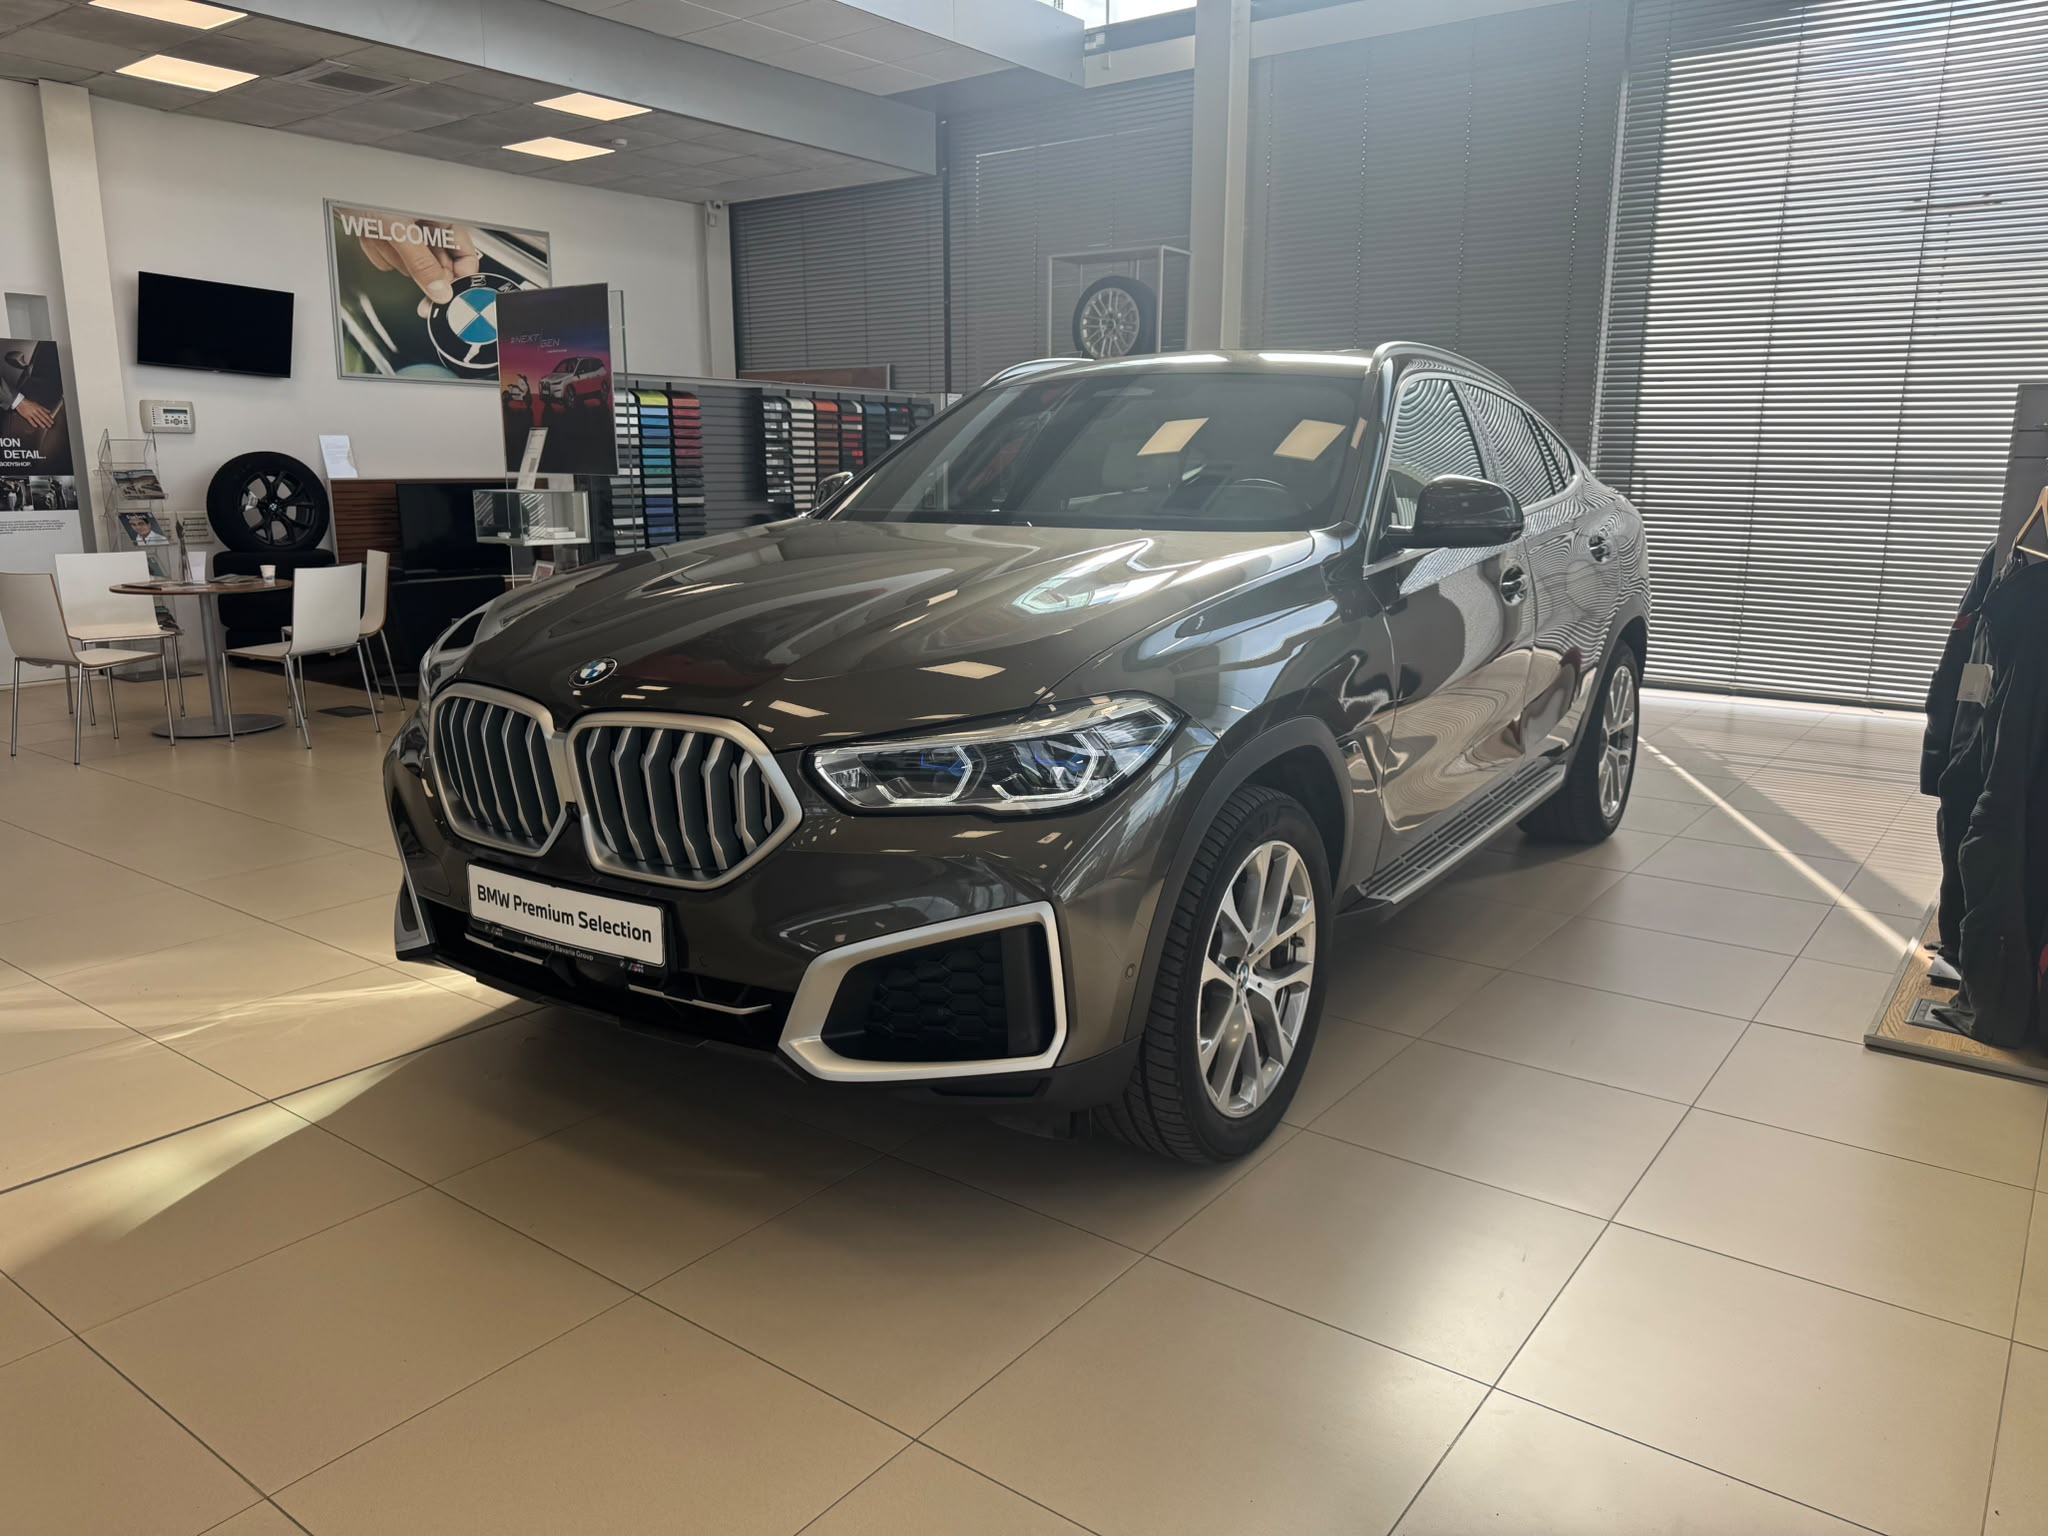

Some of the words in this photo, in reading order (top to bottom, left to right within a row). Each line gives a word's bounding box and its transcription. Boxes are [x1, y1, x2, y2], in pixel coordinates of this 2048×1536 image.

[341, 214, 461, 249] WELCOME.
[0, 437, 21, 448] ION
[4, 449, 47, 460] DETAIL.
[477, 884, 510, 909] BMW
[513, 894, 575, 926] Premium
[578, 910, 652, 943] Selection
[576, 950, 594, 961] Group
